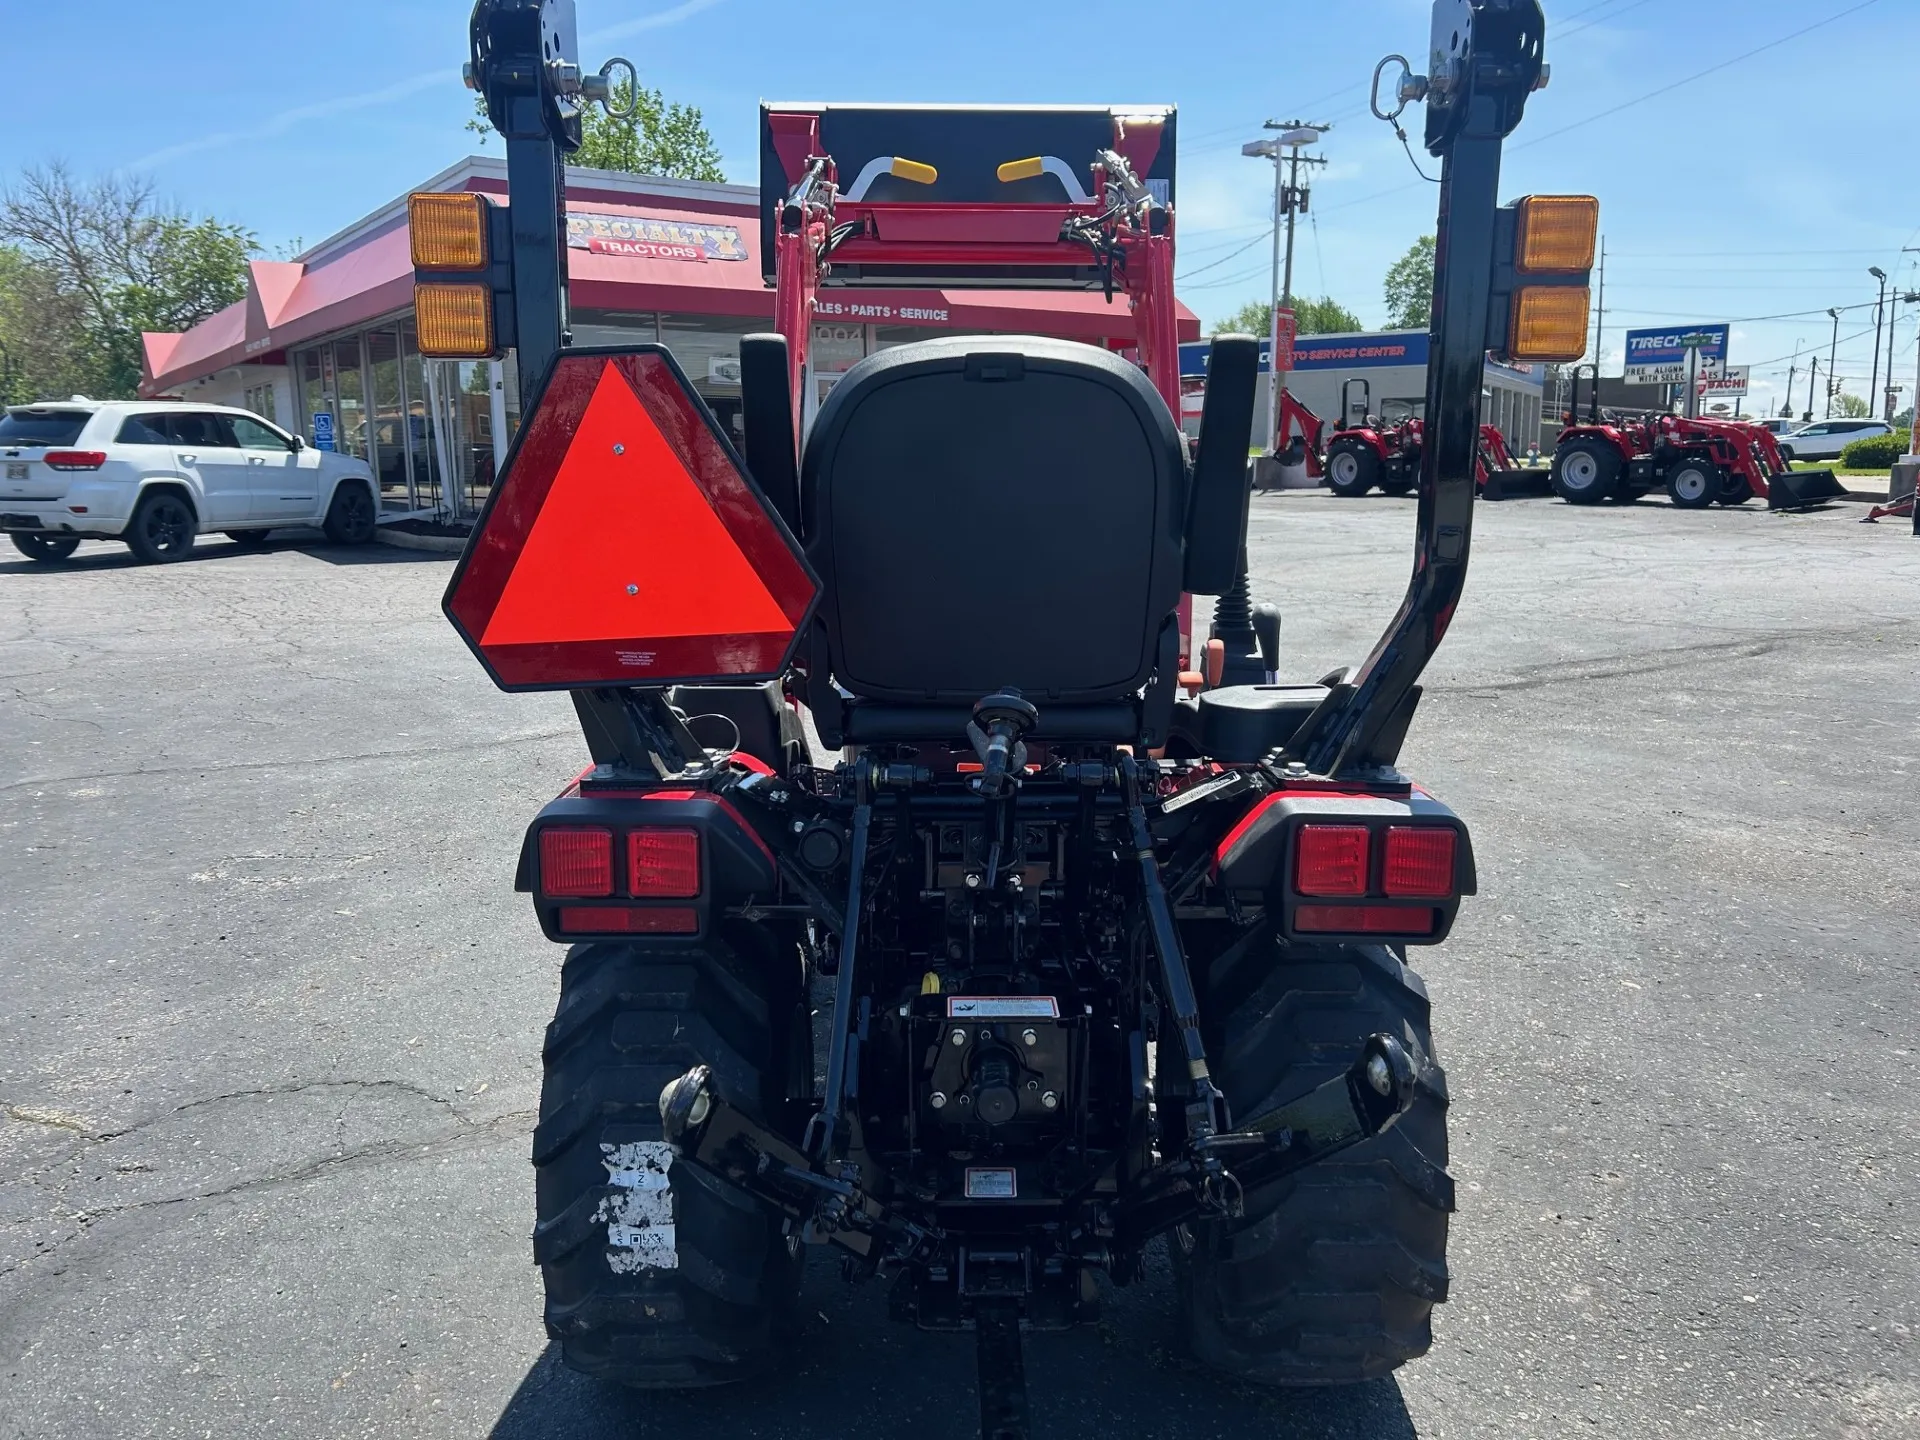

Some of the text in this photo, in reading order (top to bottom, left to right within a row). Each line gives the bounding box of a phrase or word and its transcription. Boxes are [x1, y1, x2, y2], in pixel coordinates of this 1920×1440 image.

[567, 218, 738, 255] PECIALTY
[598, 240, 697, 257] TRACTORS
[813, 303, 948, 321] ALES PARTS SERVICE
[1309, 348, 1358, 359] SERVICE
[1359, 346, 1406, 356] CENTER
[1627, 365, 1684, 376] FREE ALIGNM
[1639, 374, 1658, 383] WITH
[1661, 373, 1684, 381] SELEC
